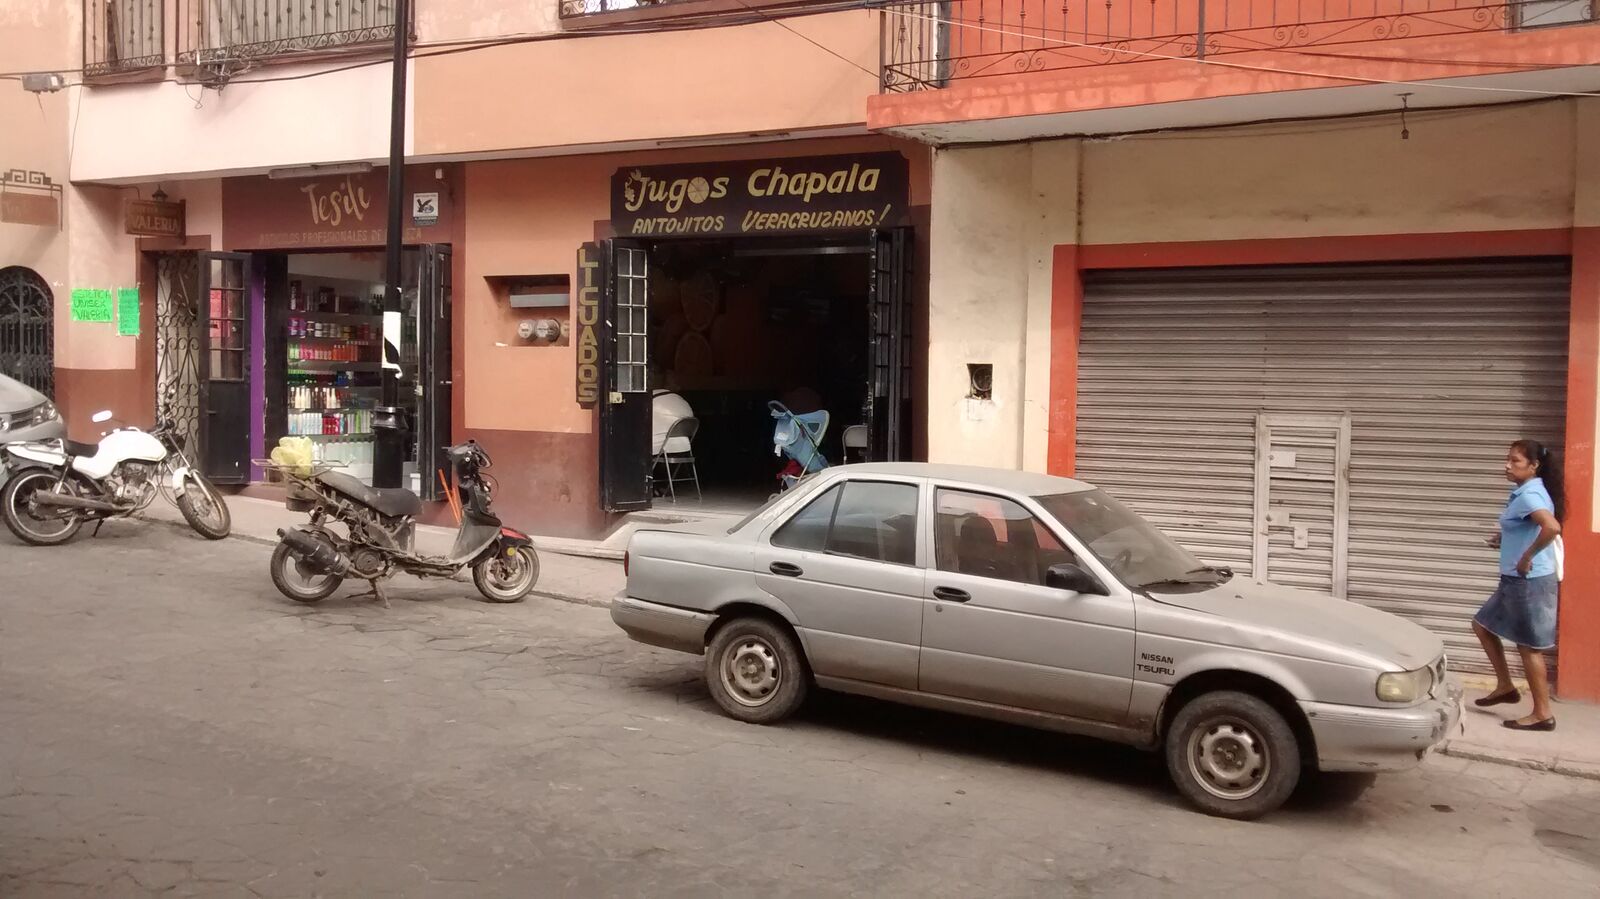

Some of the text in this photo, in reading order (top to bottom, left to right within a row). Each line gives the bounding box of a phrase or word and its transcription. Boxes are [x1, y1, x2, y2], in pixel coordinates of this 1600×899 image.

[625, 163, 881, 214] Jugos Chapala
[129, 214, 180, 232] VALERIA
[631, 203, 892, 234] ANTOJITOS VERACRUZANOS!
[578, 248, 599, 402] LICUADOS
[1136, 663, 1176, 676] TSURU
[1141, 652, 1174, 665] NISSAN
